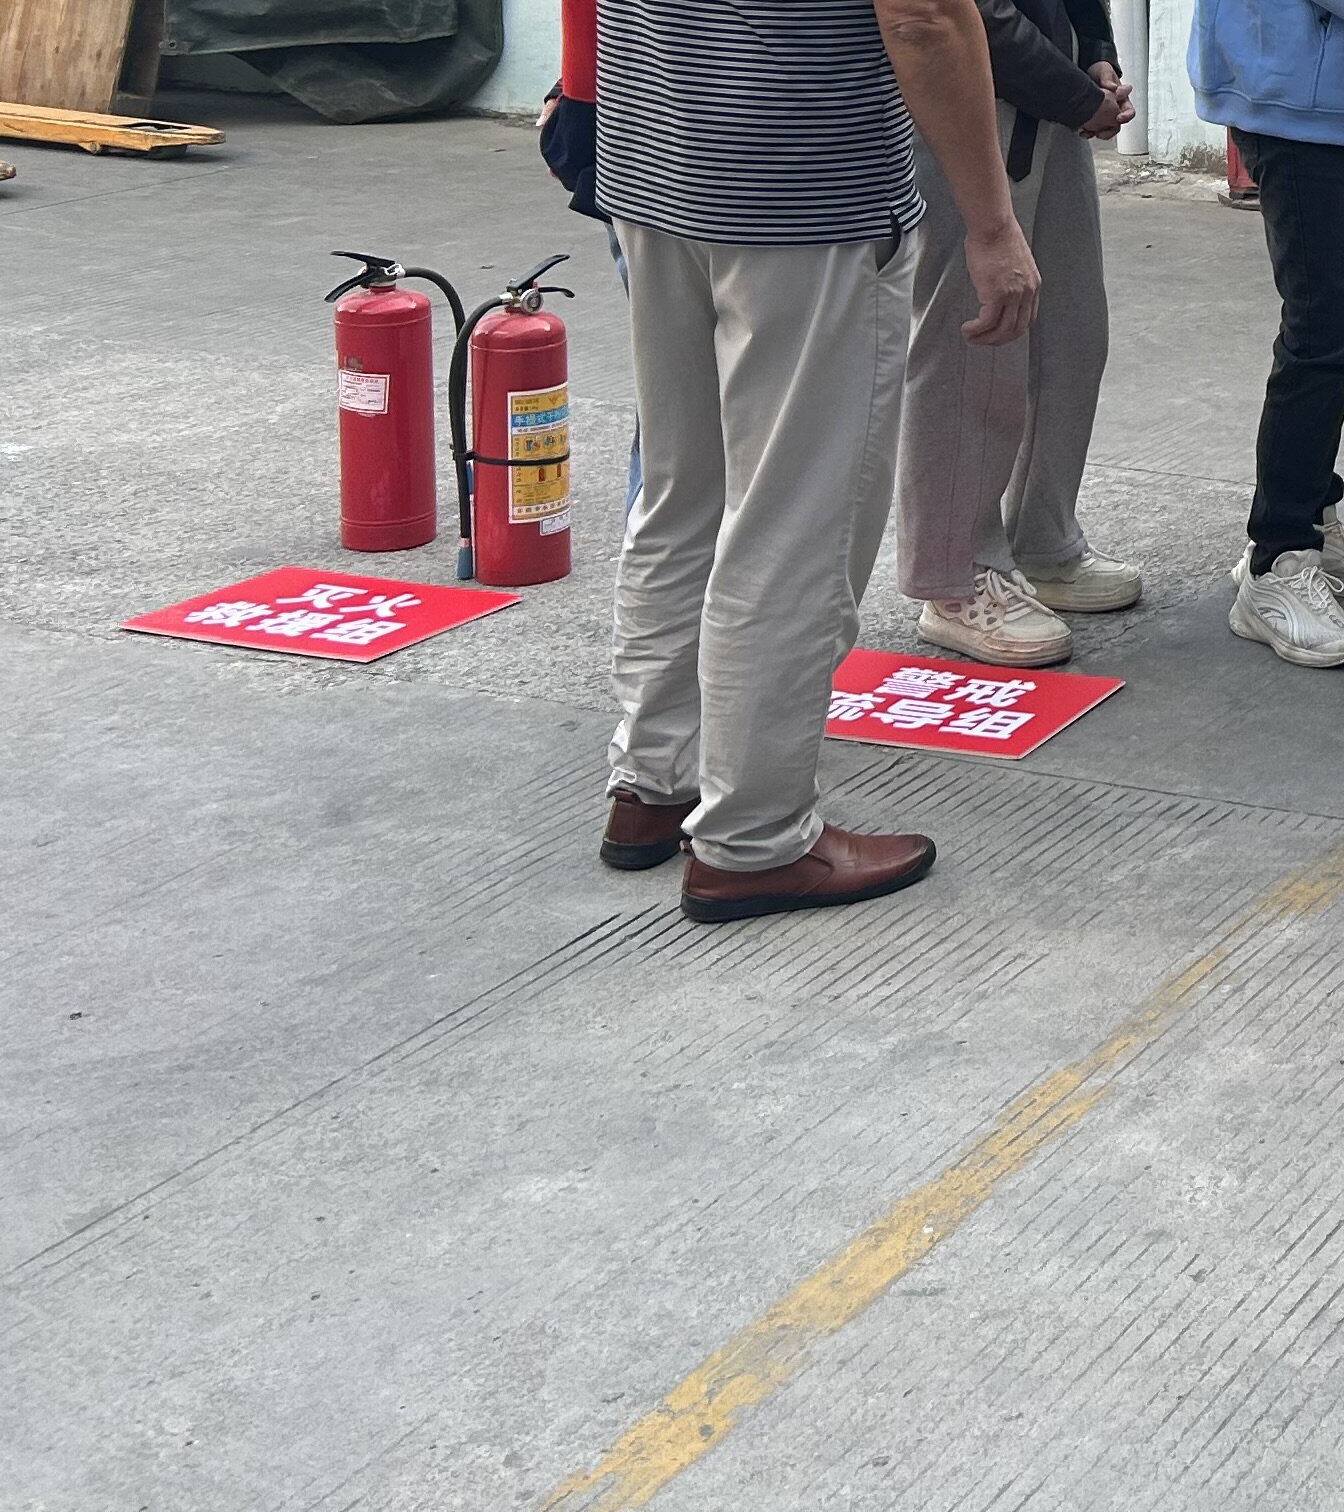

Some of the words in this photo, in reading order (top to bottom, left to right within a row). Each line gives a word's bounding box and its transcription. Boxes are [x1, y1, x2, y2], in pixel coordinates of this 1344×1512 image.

[276, 583, 421, 618] 灭火
[184, 599, 406, 645] 救援组
[873, 667, 1037, 708] 警戒
